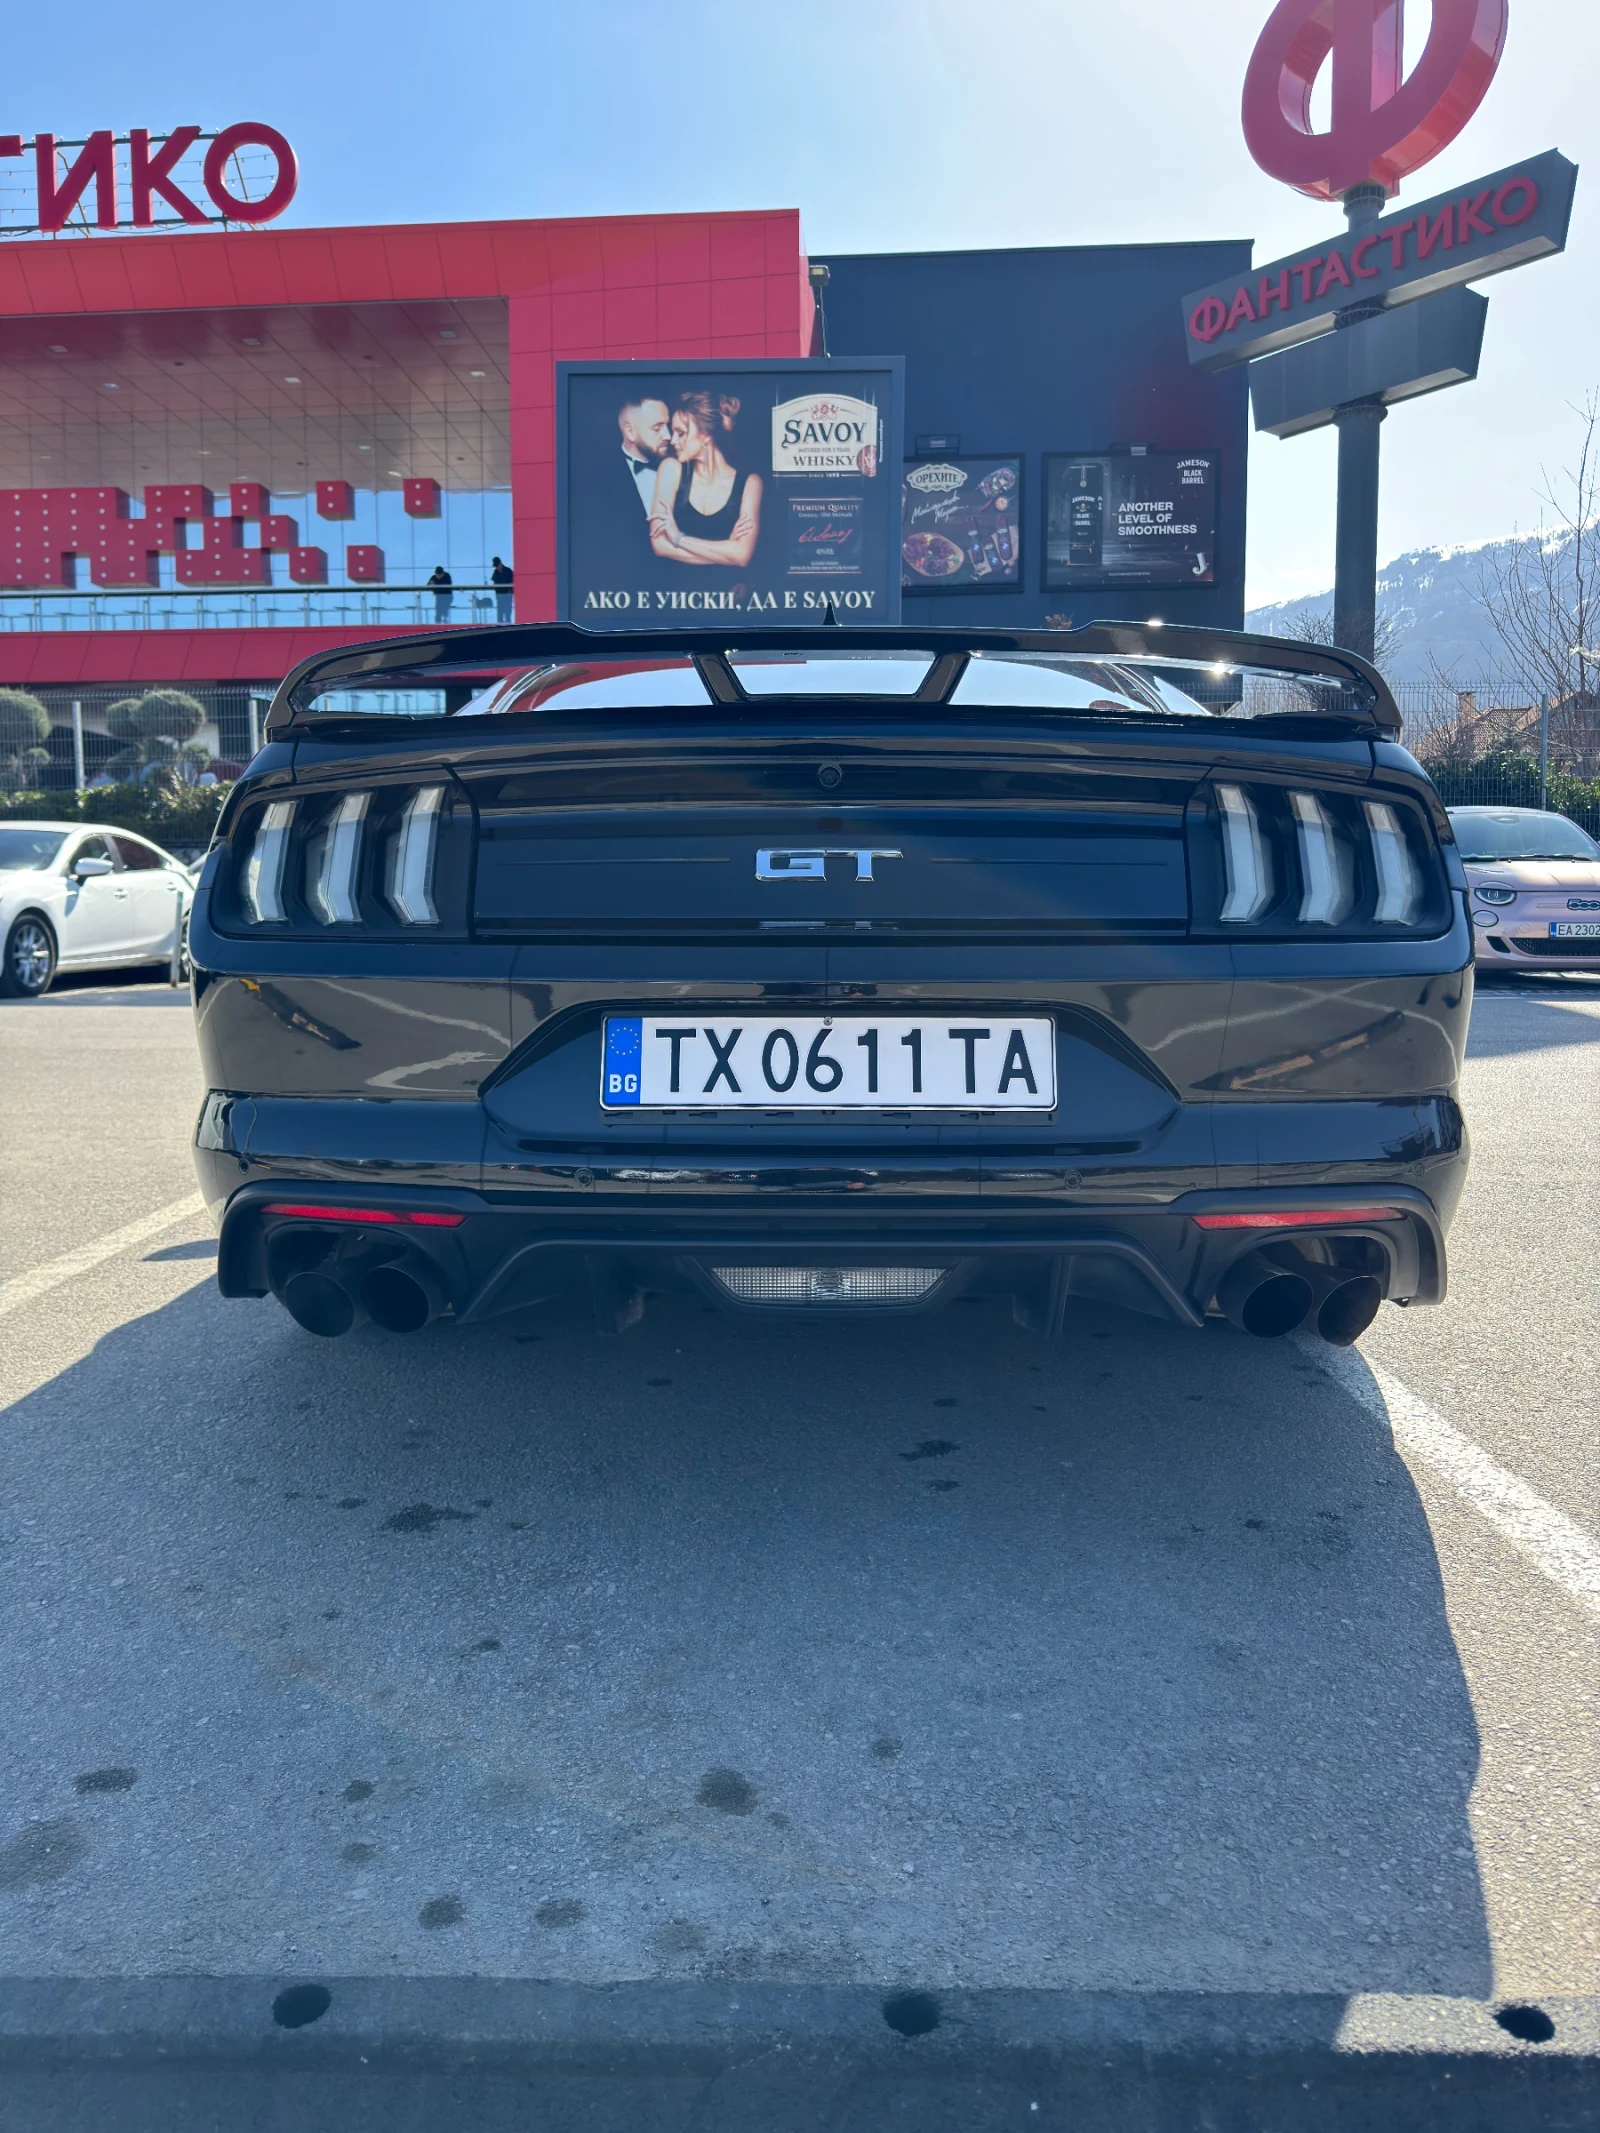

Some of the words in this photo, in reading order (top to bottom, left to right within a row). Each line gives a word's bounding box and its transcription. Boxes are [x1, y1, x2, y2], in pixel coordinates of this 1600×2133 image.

[1187, 175, 1540, 343] ФАНТАСТИКО
[781, 419, 866, 449] SAVOY
[793, 456, 856, 467] WHISKY
[1177, 459, 1210, 469] JAMESON
[915, 472, 958, 484] ОРЕХИТЕ
[1182, 477, 1204, 485] BARREL
[827, 503, 859, 512] QUALITY
[1118, 502, 1174, 512] ANOTHER
[1118, 514, 1154, 524] LEVEL
[1156, 513, 1173, 523] OF
[1117, 524, 1198, 536] SMOOTHNESS
[584, 591, 631, 609] АКО
[637, 591, 650, 609] Е
[656, 591, 742, 611] УИСКИ,
[747, 591, 778, 611] ДА
[784, 591, 797, 609] Е
[803, 590, 876, 609] SAVOY
[755, 847, 904, 882] GT
[655, 1028, 743, 1093] TX
[761, 1028, 923, 1093] 0611
[948, 1028, 1038, 1095] TA
[609, 1074, 637, 1093] BG
